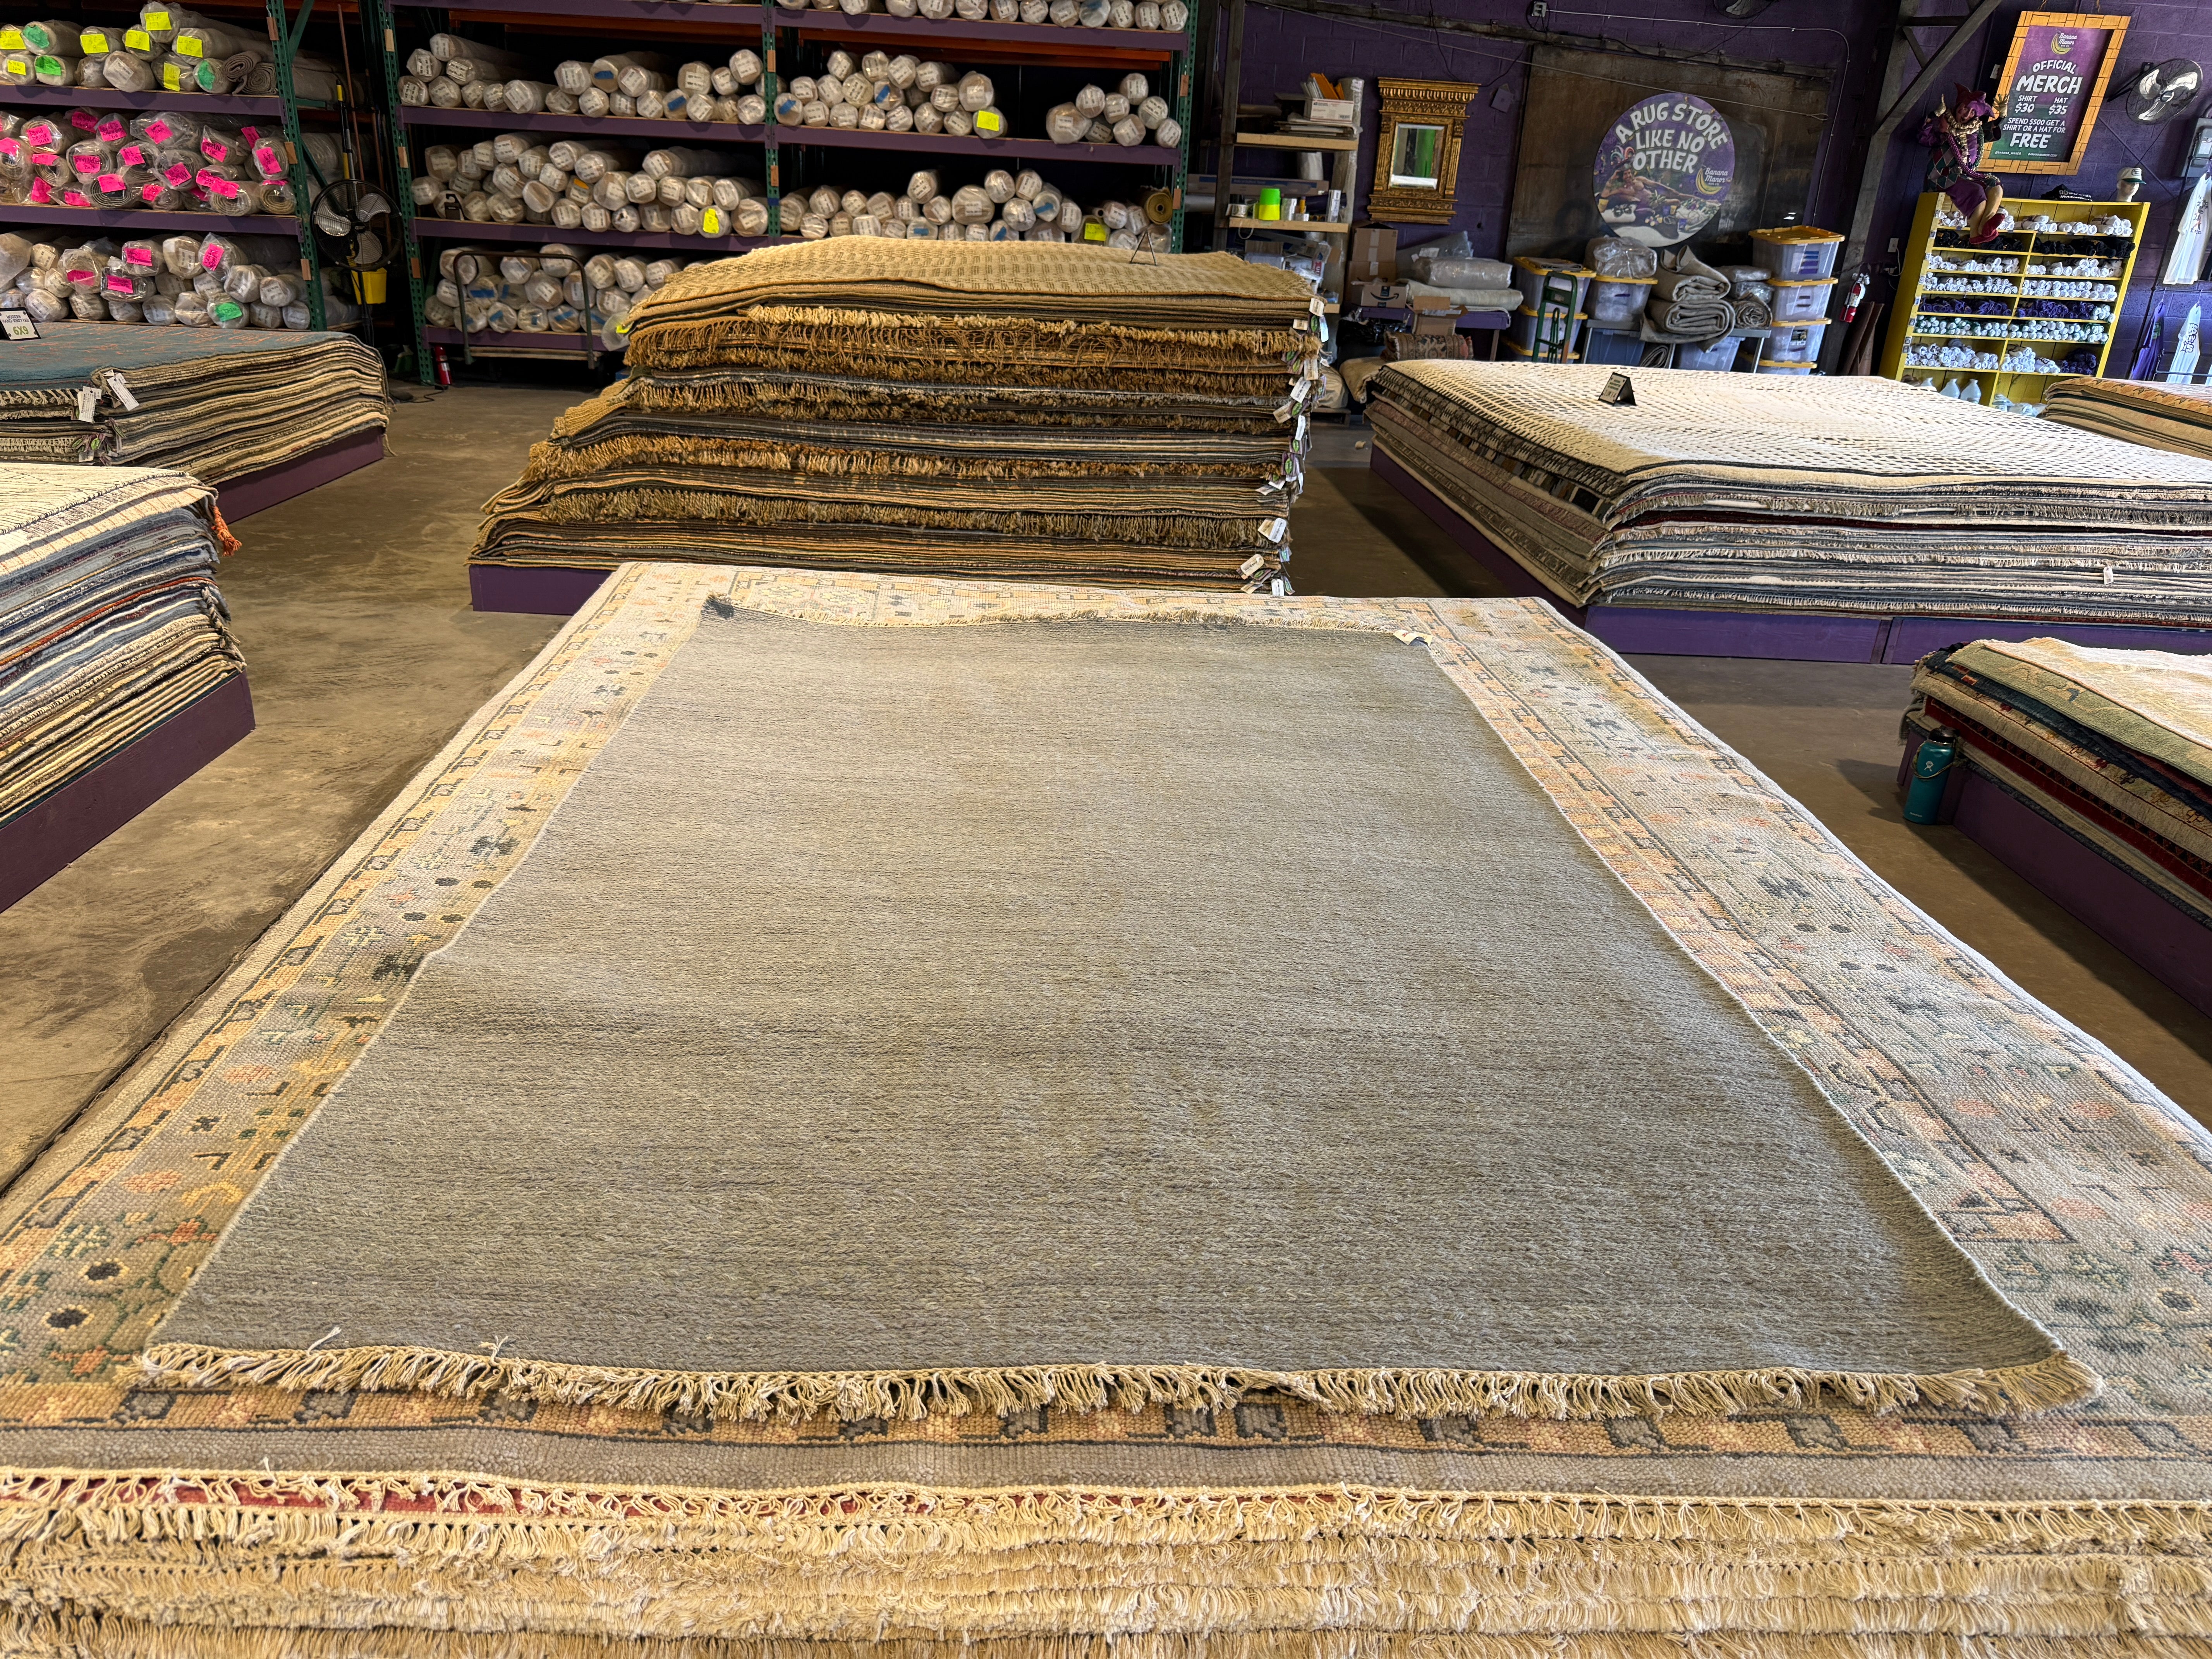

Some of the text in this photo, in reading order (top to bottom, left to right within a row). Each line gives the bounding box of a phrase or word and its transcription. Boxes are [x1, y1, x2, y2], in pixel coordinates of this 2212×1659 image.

[2033, 60, 2076, 74] OFFICIAL
[2016, 75, 2083, 94] MERCH
[2015, 102, 2035, 113] $30
[2049, 104, 2068, 115] $35
[1615, 102, 1728, 149] A RUG STORE
[1635, 129, 1705, 153] LIKE NO
[2009, 132, 2052, 149] FREE
[1633, 149, 1698, 174] OTHER
[1705, 167, 1728, 176] Banana
[13, 326, 29, 335] 6X9
